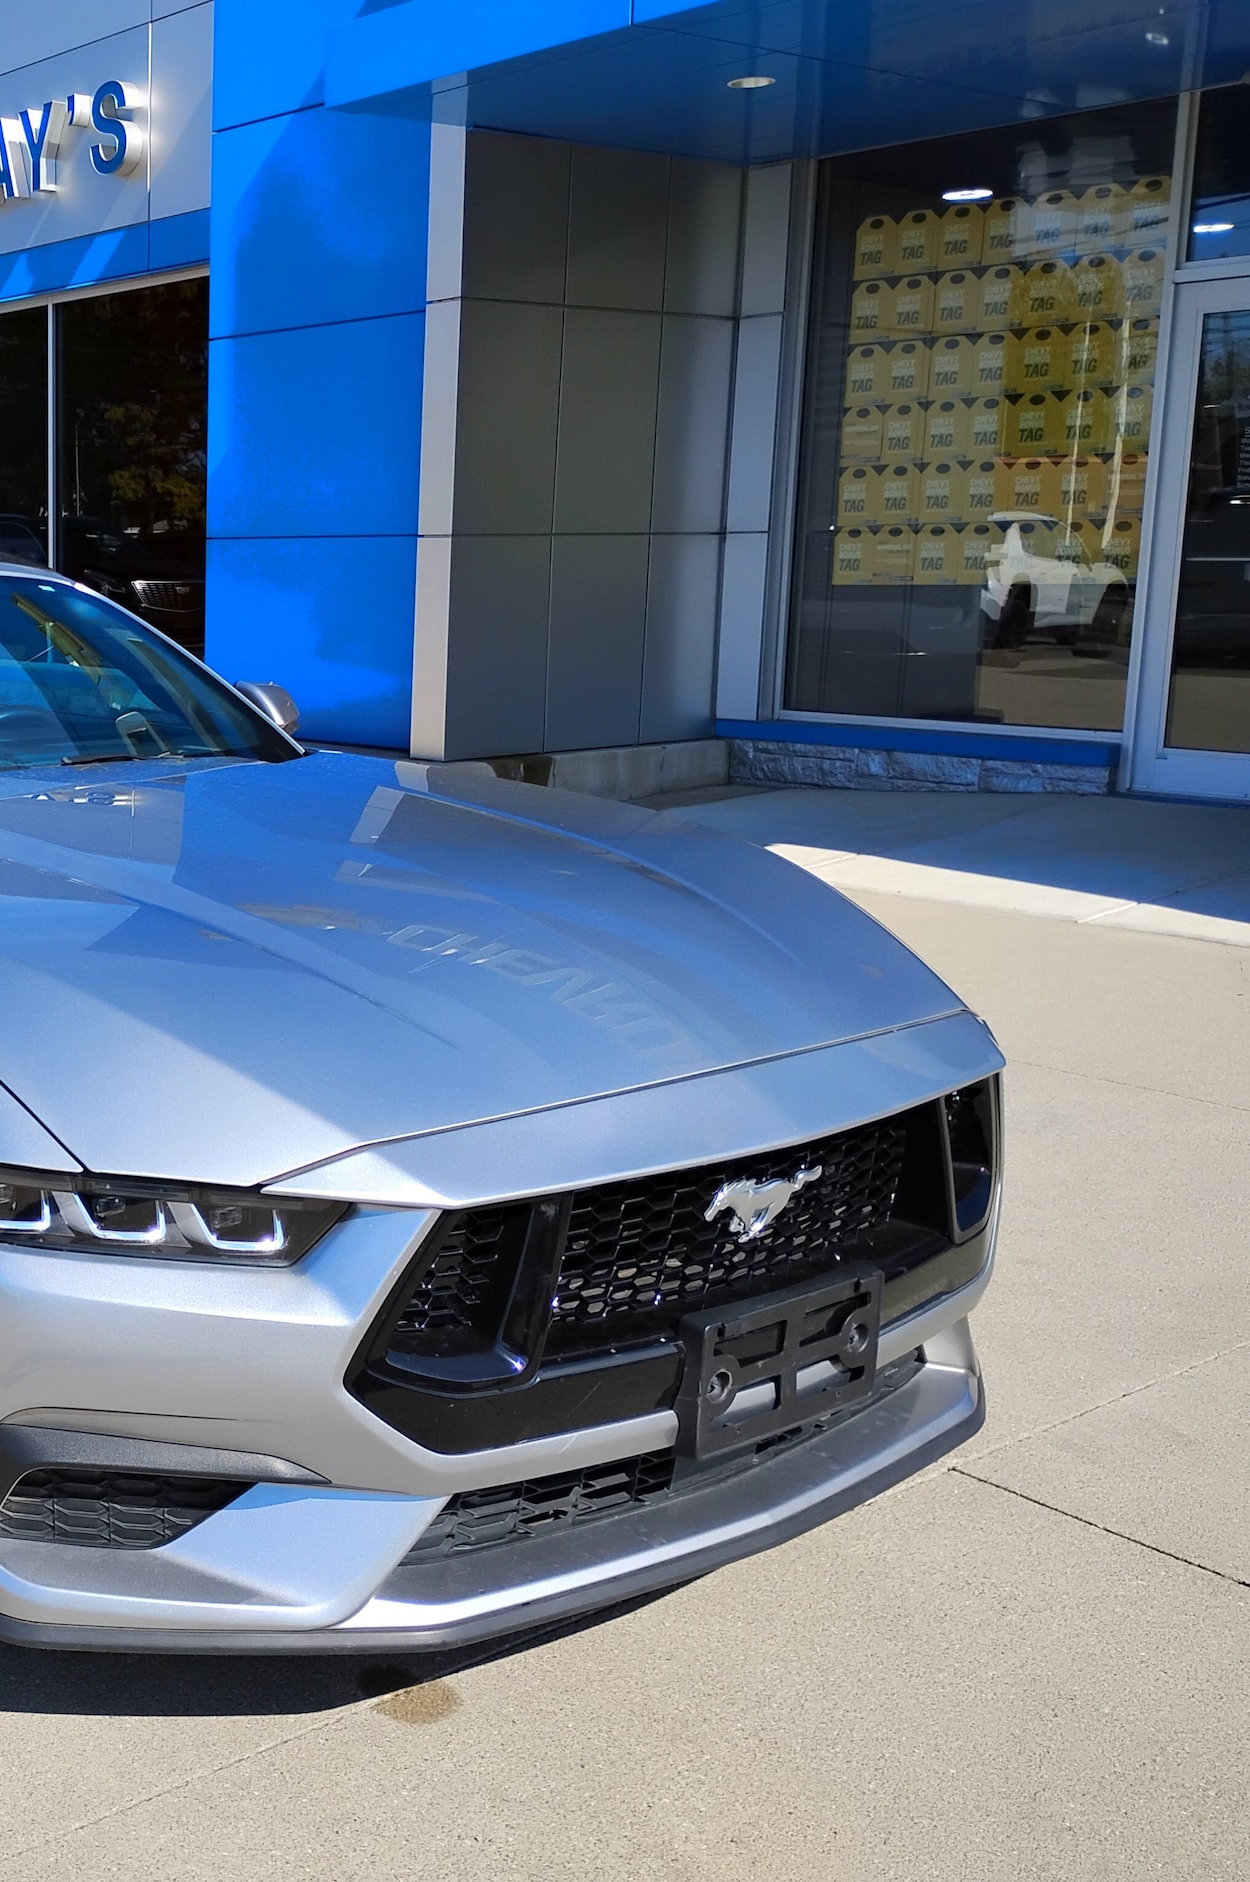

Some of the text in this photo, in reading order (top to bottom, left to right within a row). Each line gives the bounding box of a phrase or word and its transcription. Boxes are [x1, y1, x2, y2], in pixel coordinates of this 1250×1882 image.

[944, 240, 967, 255] TAG
[990, 234, 1013, 250] TAG
[860, 251, 882, 266] TAG
[901, 245, 924, 260] TAG
[1029, 297, 1054, 312] TAG
[1077, 291, 1103, 307] TAG
[940, 306, 963, 321] TAG
[984, 302, 1008, 317] TAG
[856, 315, 877, 329] TAG
[896, 311, 919, 325] TAG
[979, 367, 1002, 382] TAG
[1024, 363, 1049, 378] TAG
[851, 378, 872, 392] TAG
[892, 376, 914, 390] TAG
[935, 371, 958, 386] TAG
[930, 433, 953, 448] TAG
[974, 431, 997, 445] TAG
[1018, 428, 1044, 443] TAG
[887, 437, 910, 450] TAG
[843, 499, 865, 513] TAG
[884, 497, 907, 510] TAG
[926, 495, 948, 509] TAG
[969, 494, 993, 508] TAG
[1015, 492, 1039, 506] TAG
[839, 558, 860, 571] TAG
[920, 557, 943, 570] TAG
[964, 557, 986, 570] TAG
